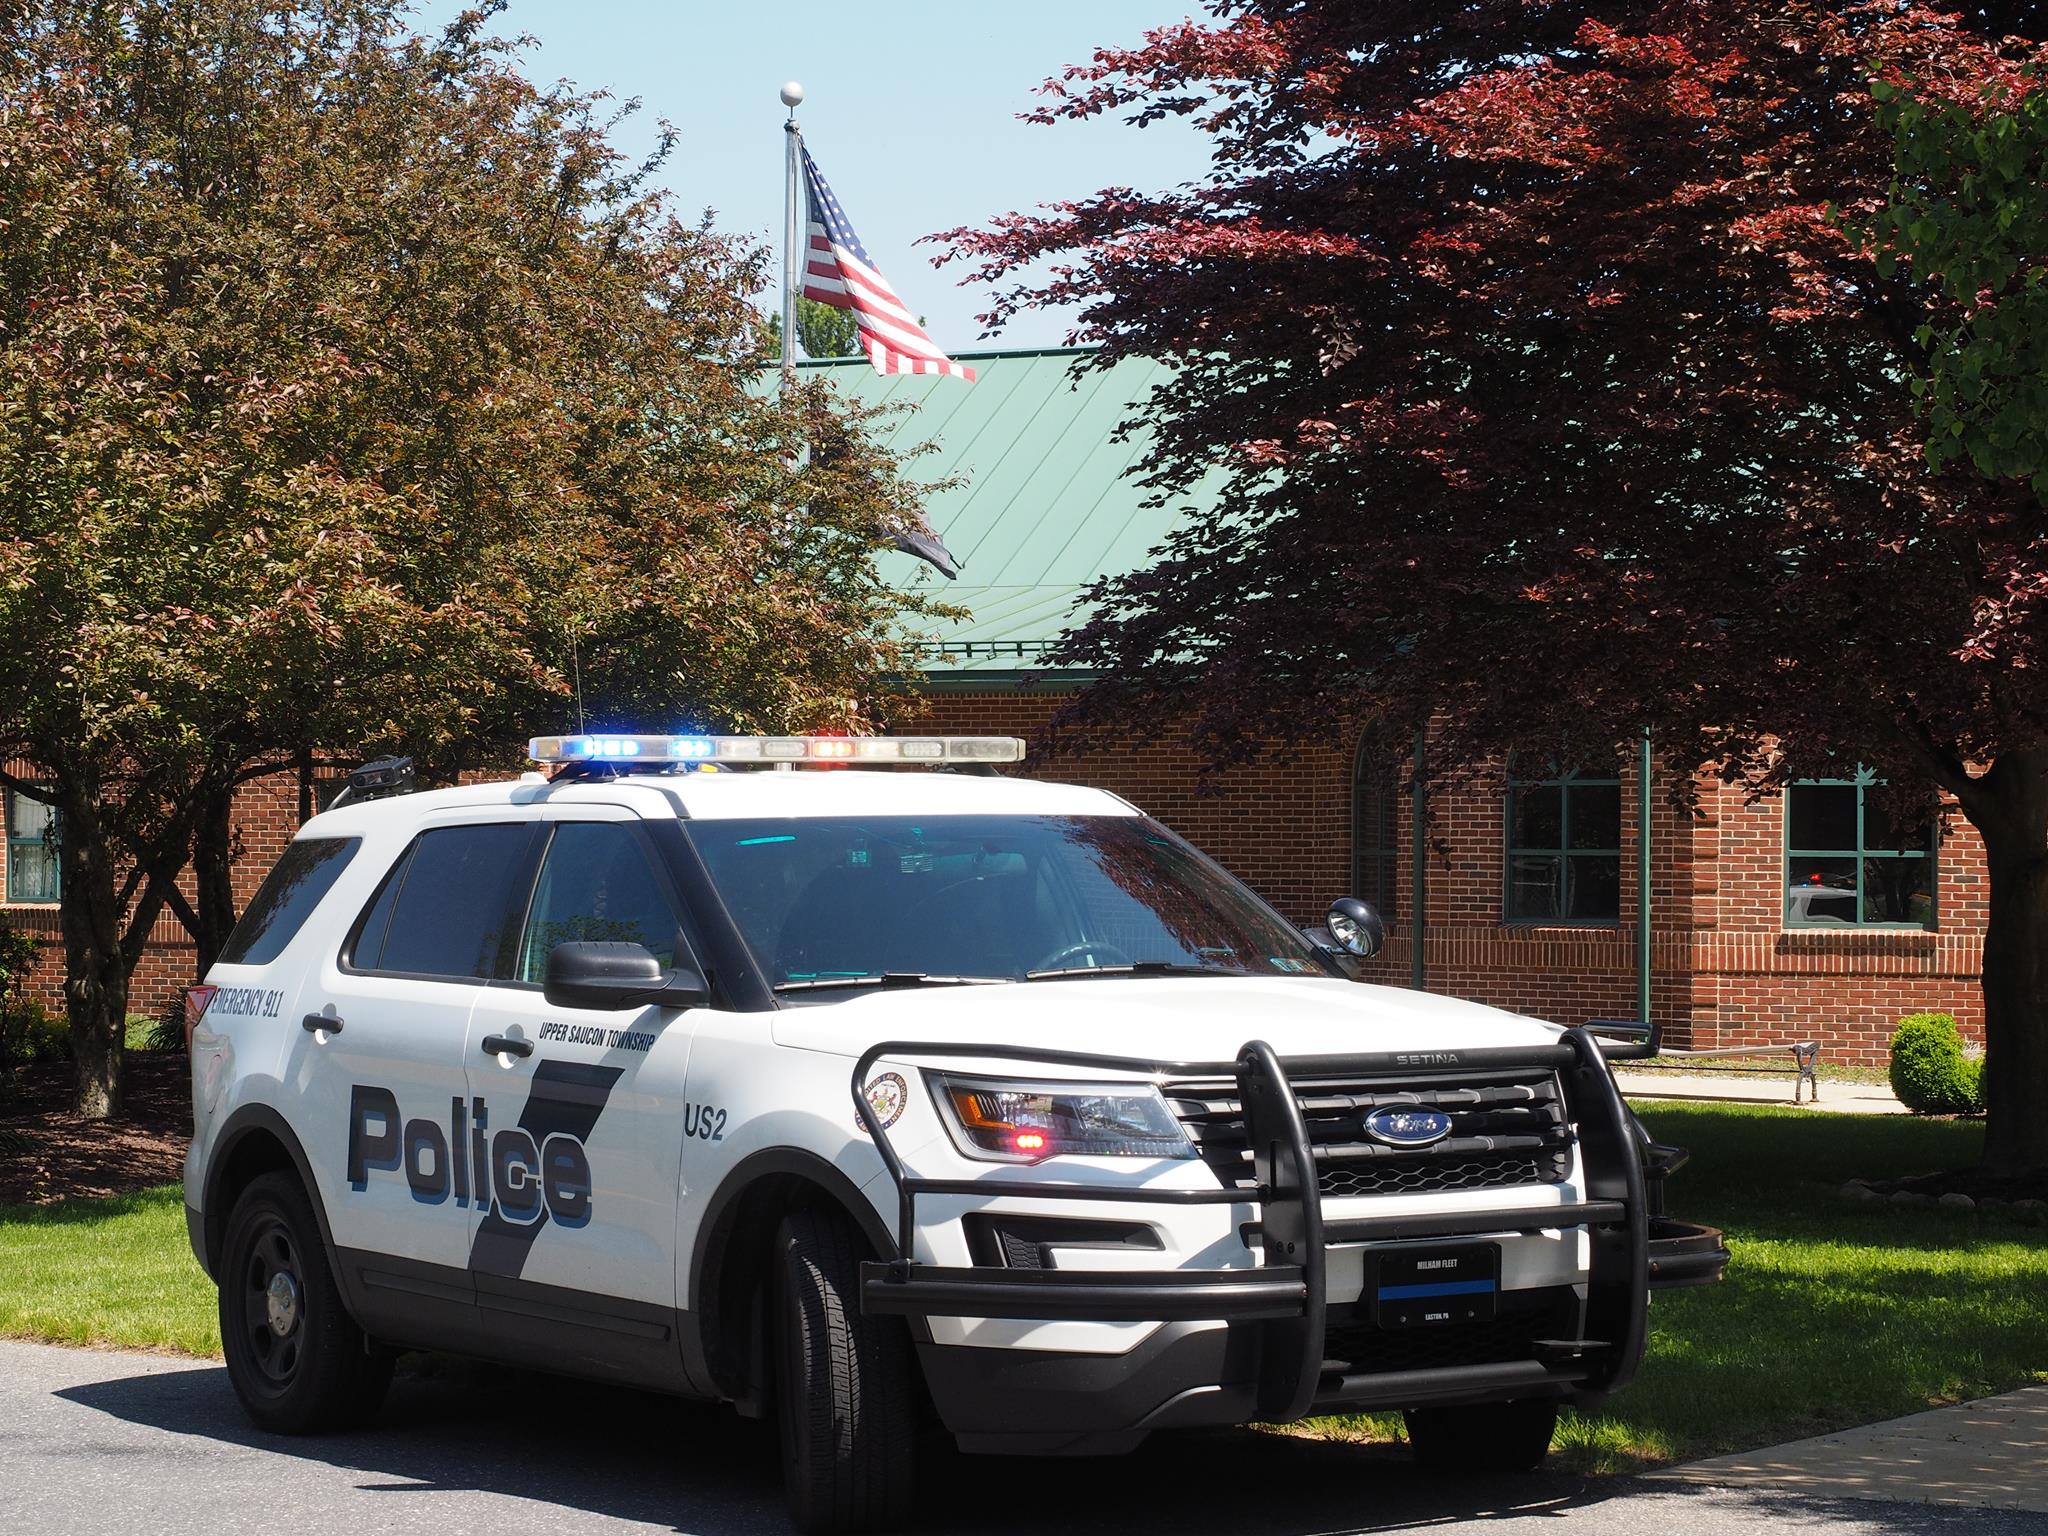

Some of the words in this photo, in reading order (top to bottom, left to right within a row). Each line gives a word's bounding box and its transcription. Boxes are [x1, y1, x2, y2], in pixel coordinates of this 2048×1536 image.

[211, 987, 266, 1016] EMERGENCY
[263, 989, 284, 1018] 911
[539, 1021, 569, 1042] UPPER
[568, 1024, 607, 1047] SAUCON
[606, 1029, 656, 1052] TOWNSHIP
[1396, 1054, 1459, 1065] SETINA
[684, 1102, 728, 1141] US2
[347, 1084, 592, 1229] Police
[1417, 1260, 1441, 1270] MILHAM
[1441, 1258, 1458, 1269] FLEET
[1443, 1312, 1449, 1320] PA
